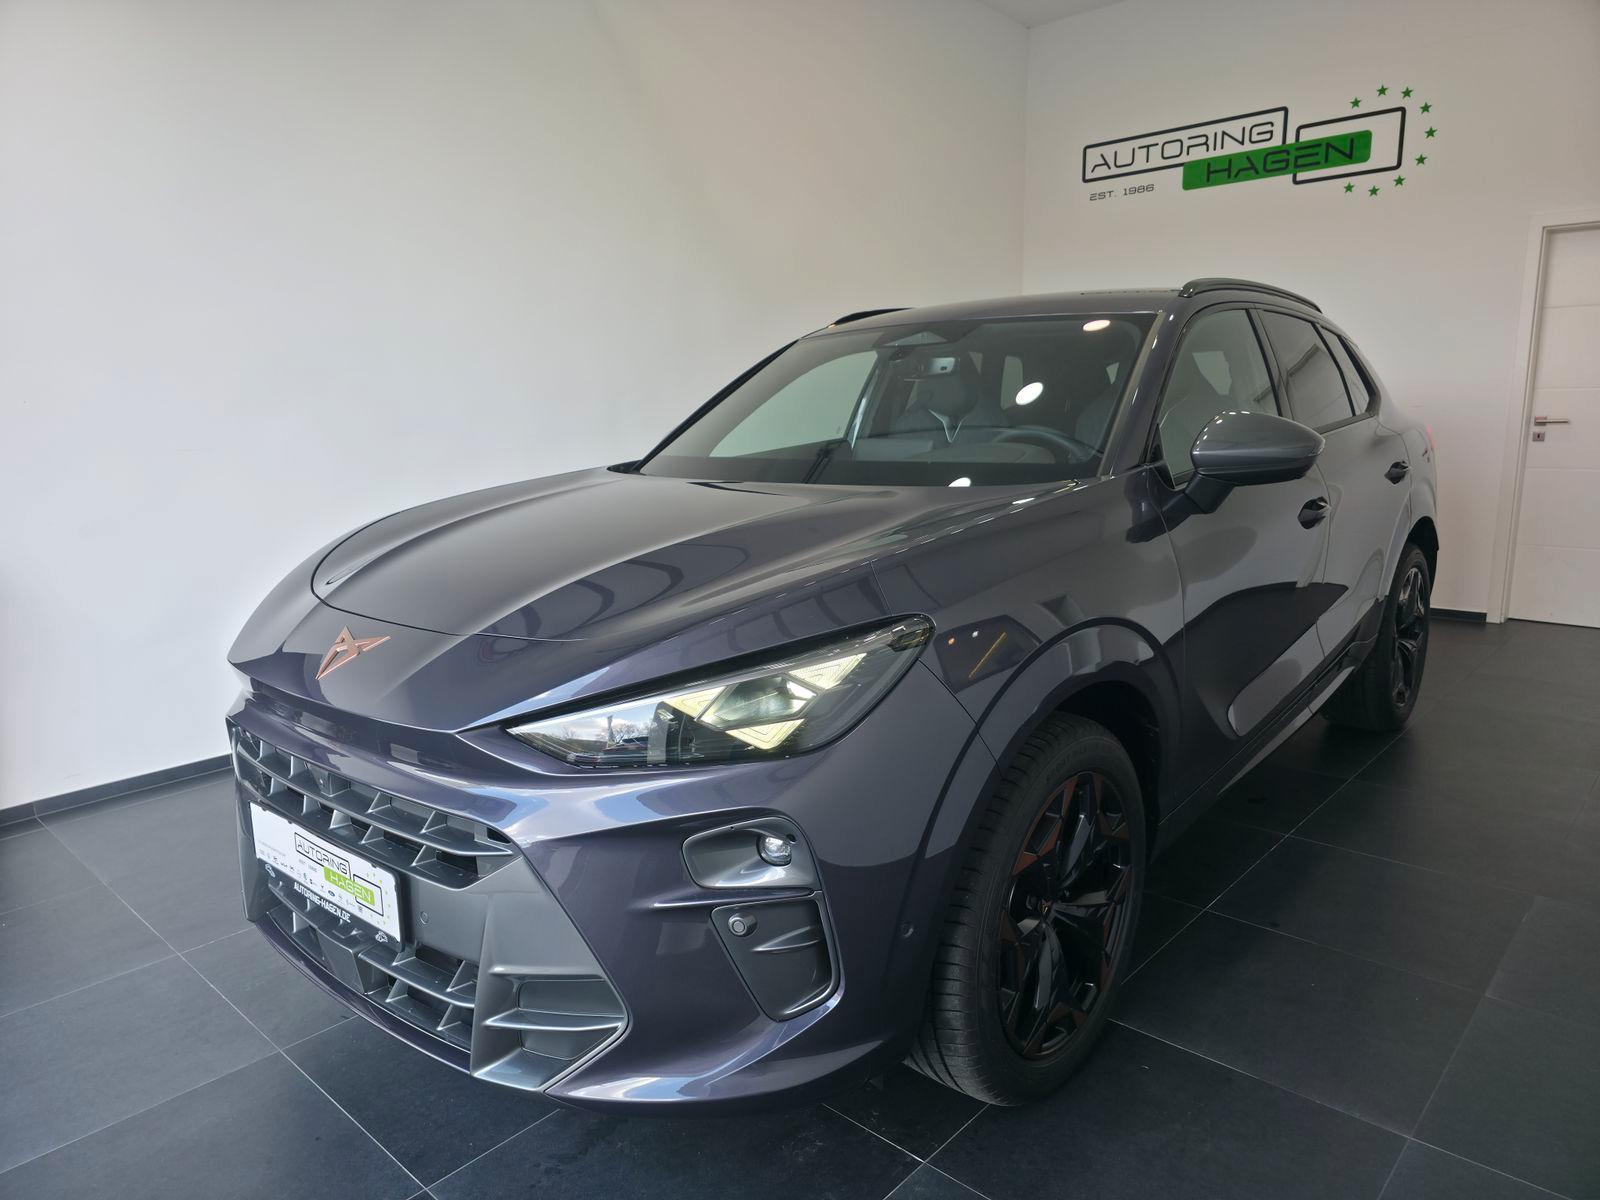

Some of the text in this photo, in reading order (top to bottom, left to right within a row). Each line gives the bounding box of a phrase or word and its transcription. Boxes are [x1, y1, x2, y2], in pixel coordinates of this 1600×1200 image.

[1091, 121, 1275, 173] AUTORING
[1206, 137, 1355, 183] HAGEN
[1089, 183, 1155, 201] EST. 1986
[297, 839, 348, 875] AUTORING
[328, 872, 373, 902] HAGEN
